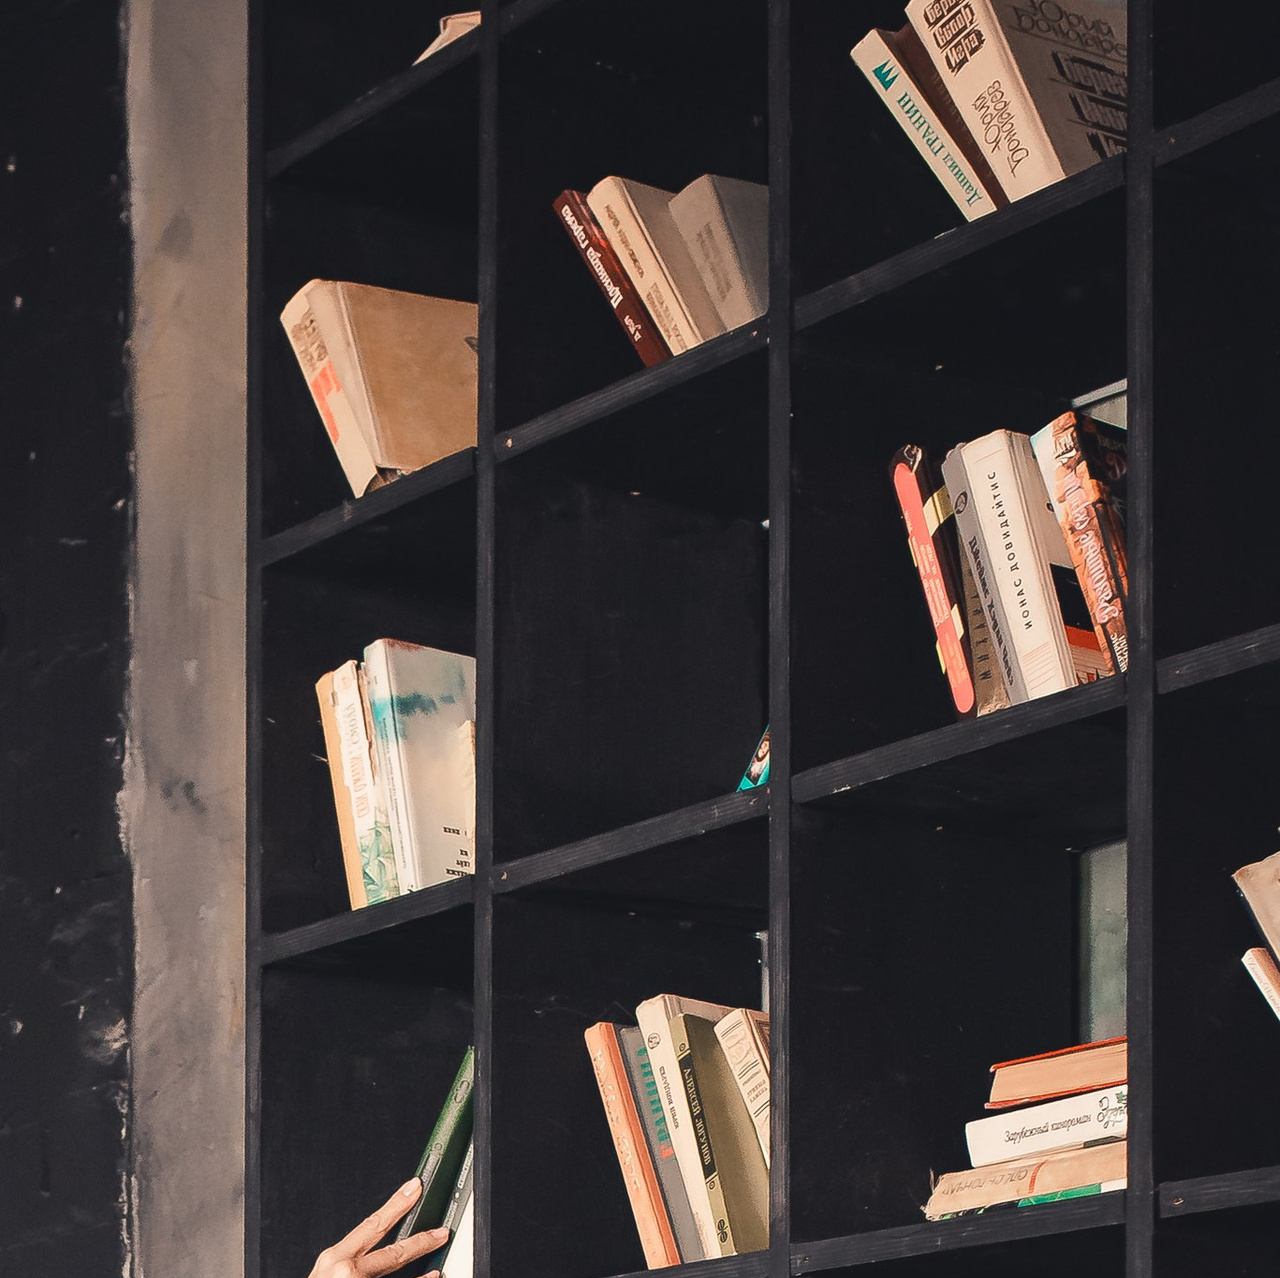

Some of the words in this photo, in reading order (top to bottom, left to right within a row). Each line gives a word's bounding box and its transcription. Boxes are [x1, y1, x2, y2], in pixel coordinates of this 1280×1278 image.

[924, 0, 960, 23] Бер
[934, 6, 973, 47] Выбор
[1005, 5, 1127, 56] Бондаре
[946, 32, 979, 68] Игра
[895, 91, 947, 157] ГРАНИН
[971, 92, 1002, 154] Юрий
[987, 80, 1029, 178] Бондарев
[942, 154, 983, 207] Даниил
[988, 470, 1020, 573] ДОВИДАЙТИС
[1014, 578, 1033, 630] ИОНАС
[659, 1065, 673, 1105] БОНДАРЕВ
[683, 1067, 702, 1119] АЛЕКСЕЙ
[670, 1106, 679, 1129] ЮРИЙ
